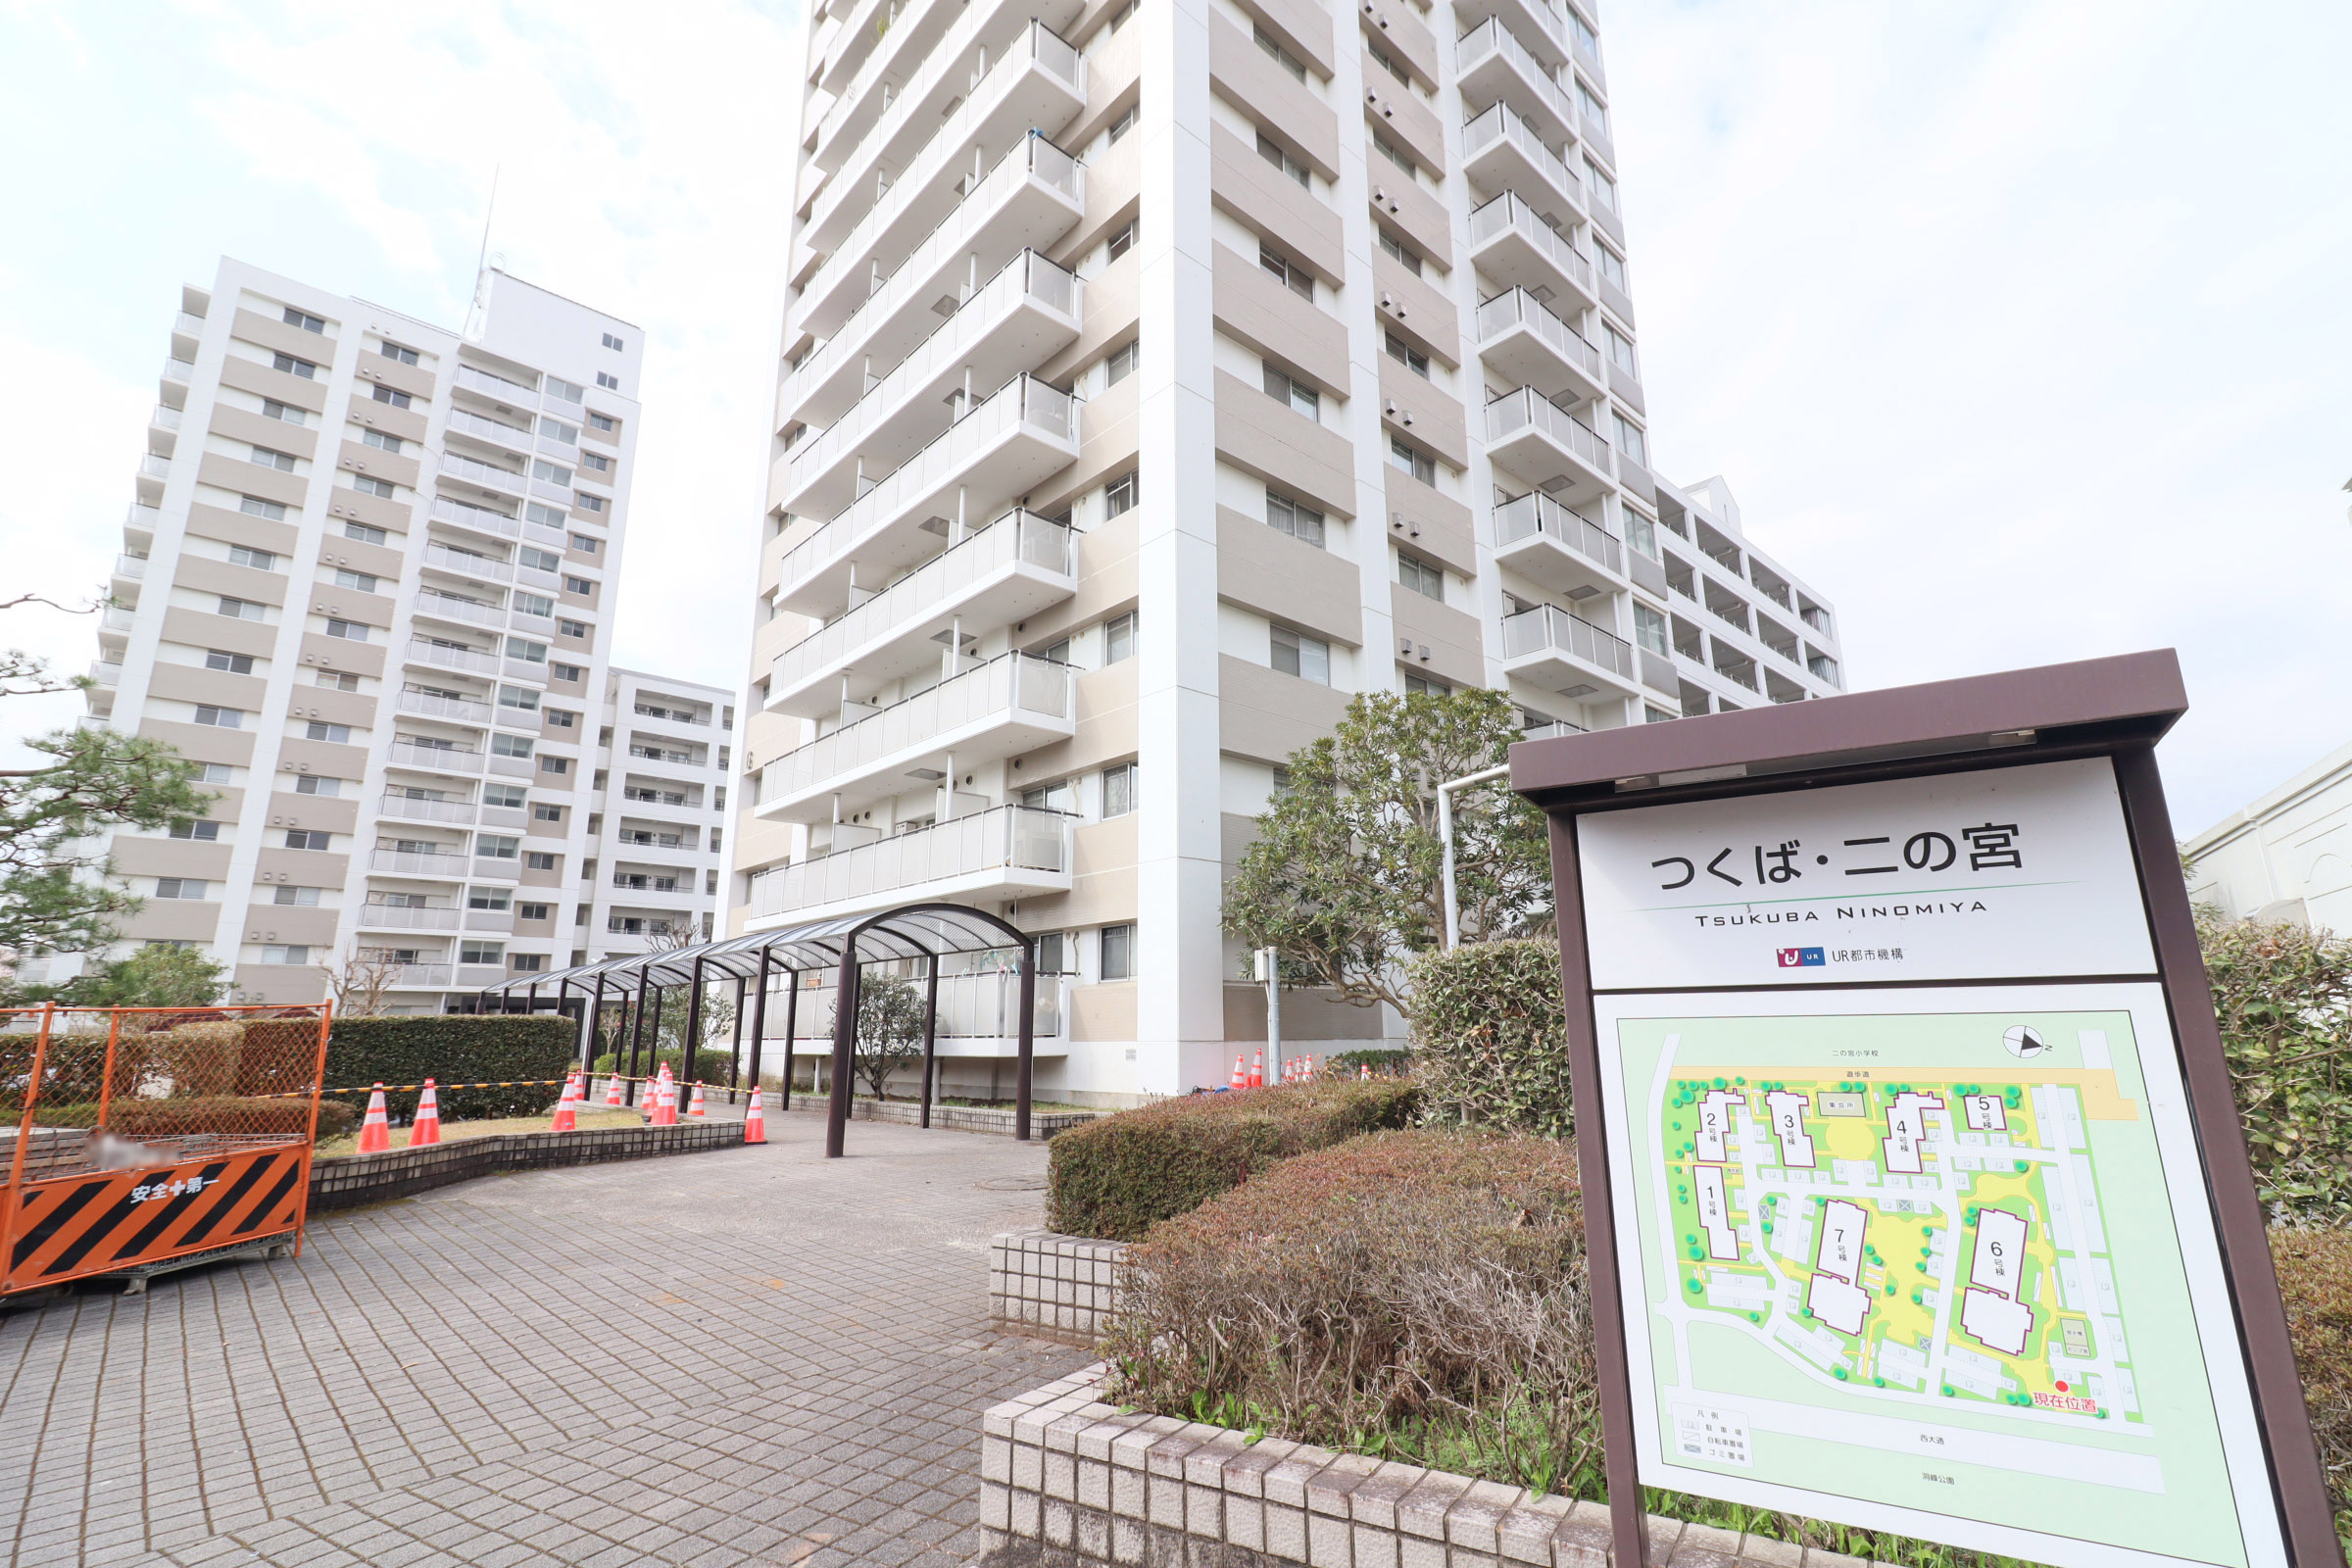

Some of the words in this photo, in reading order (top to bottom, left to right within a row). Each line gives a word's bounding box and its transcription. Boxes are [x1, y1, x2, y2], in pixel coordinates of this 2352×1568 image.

[1650, 822, 2023, 890] つくば・二の宮
[1695, 908, 1820, 928] TSUKUBA
[1838, 900, 1988, 919] NINOMIYA
[1832, 948, 1904, 962] UR都市機構
[2034, 1392, 2098, 1413] 現在位置
